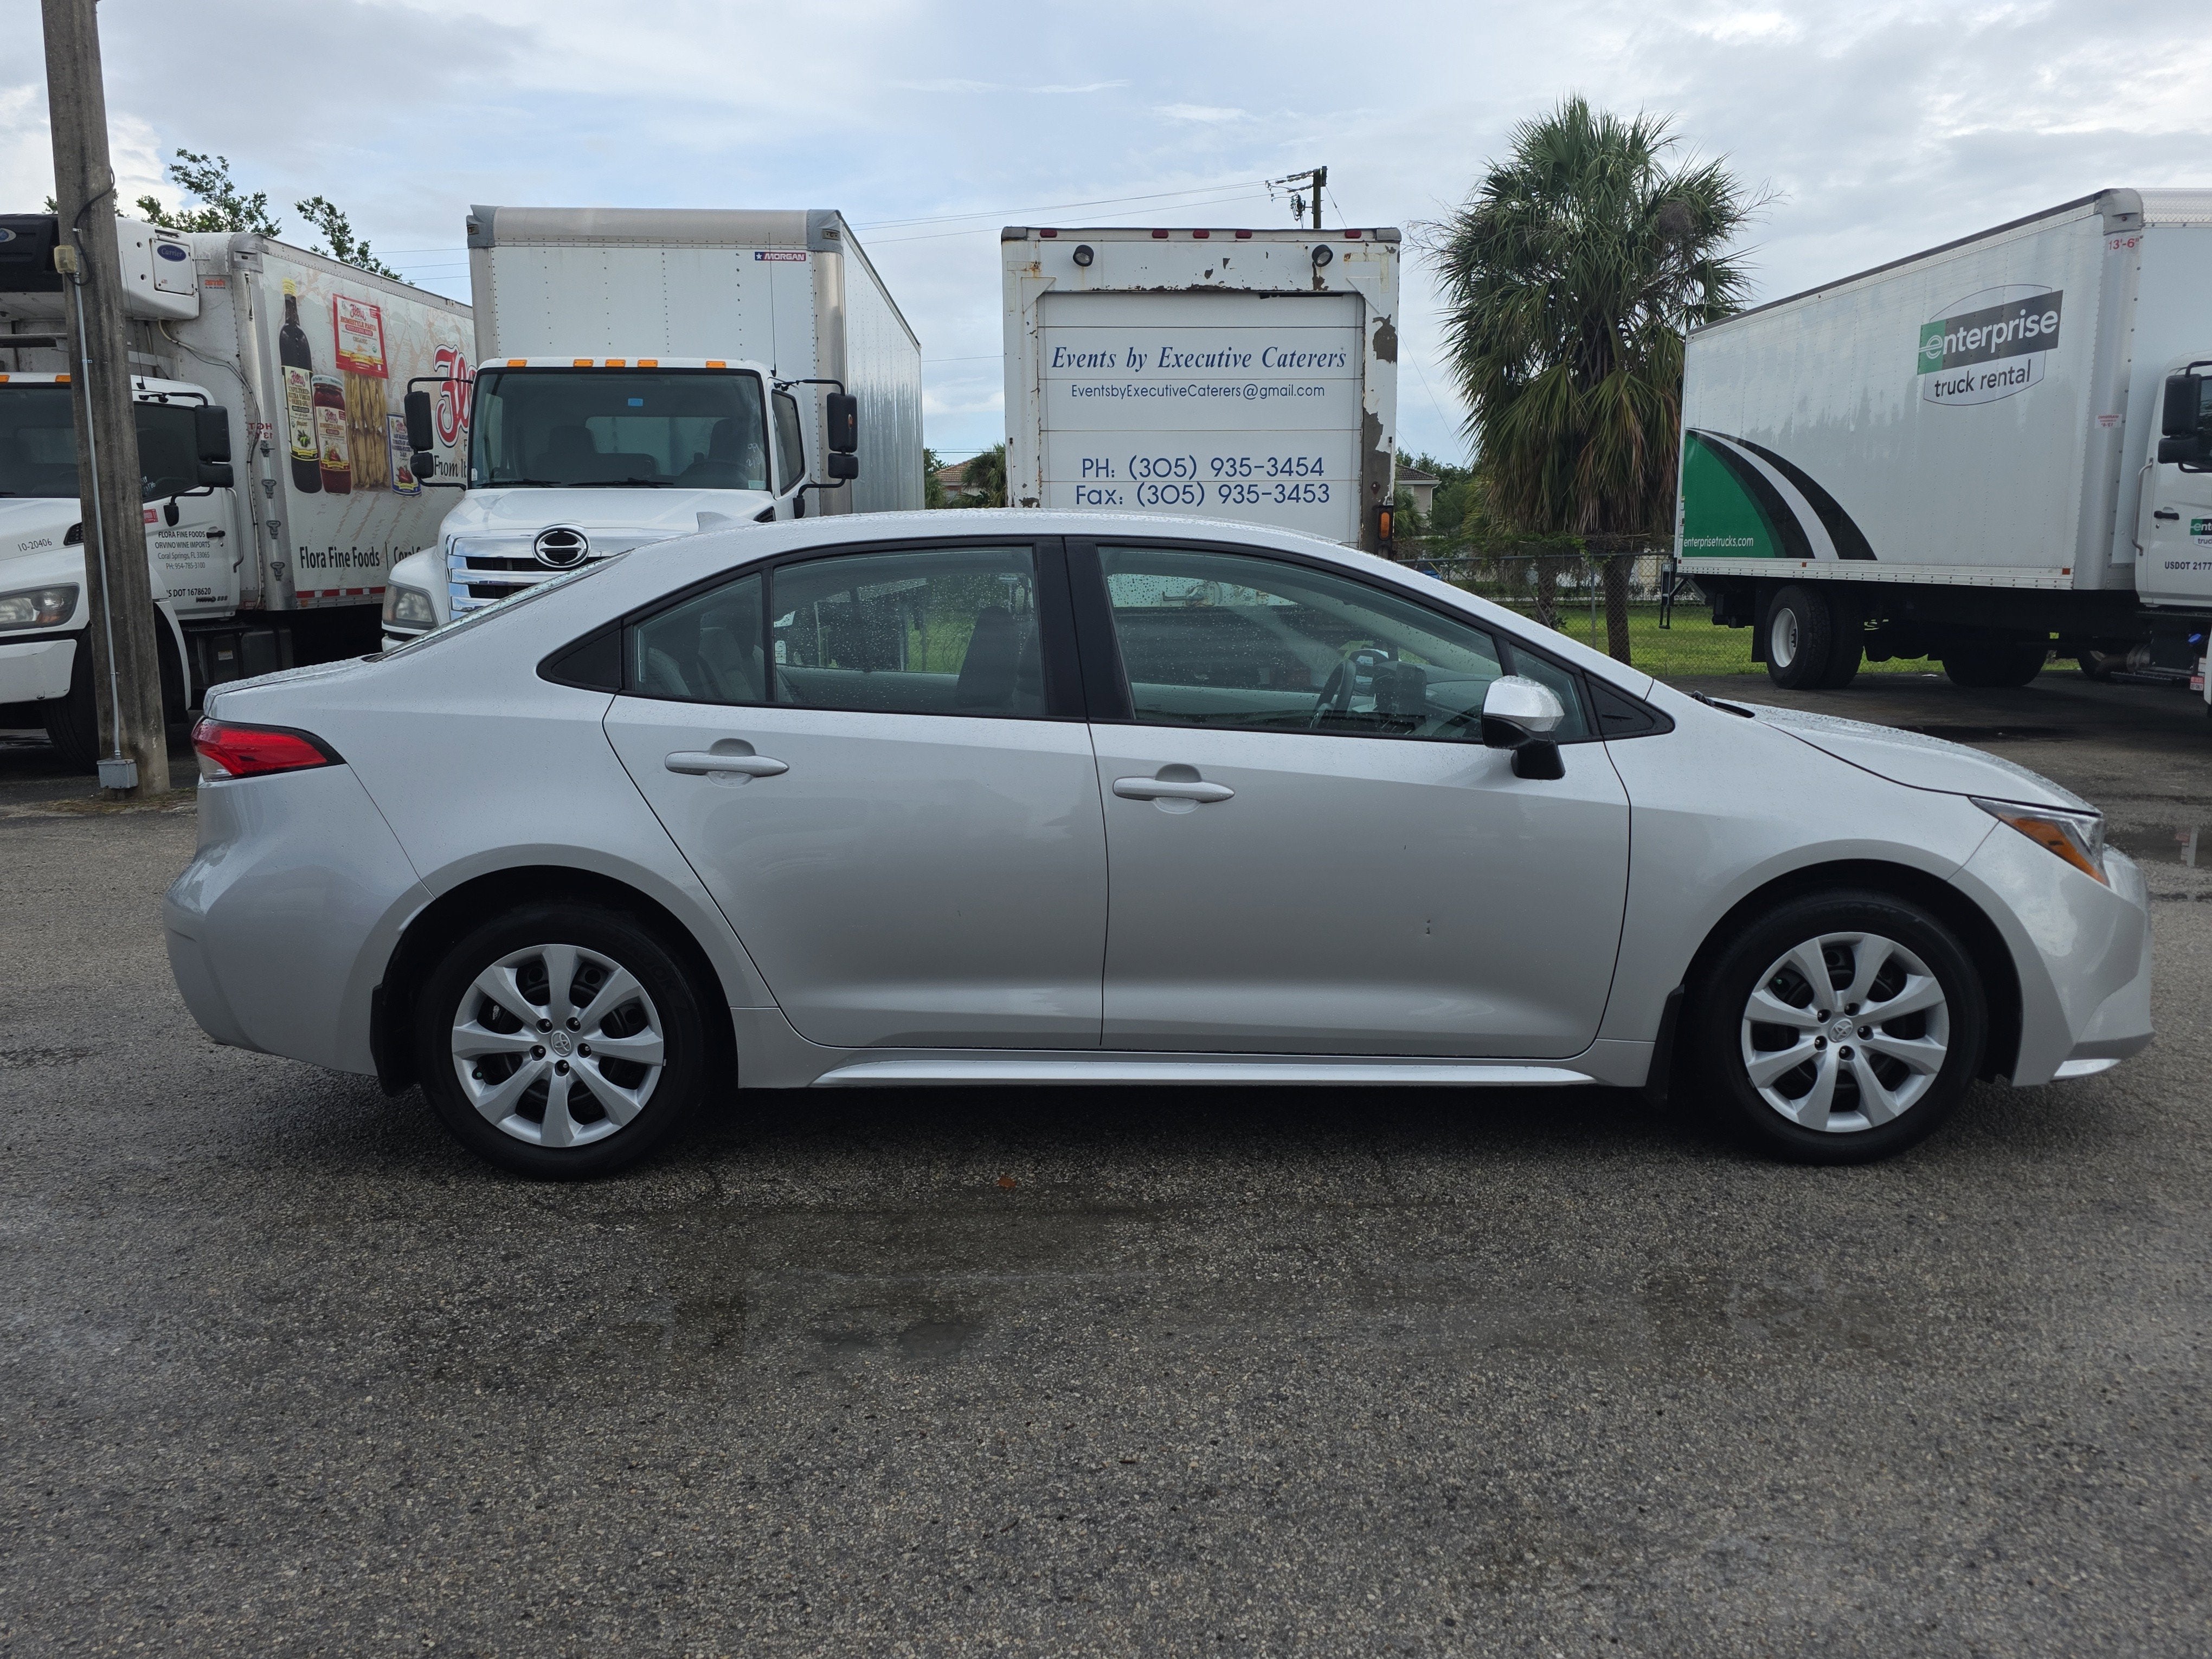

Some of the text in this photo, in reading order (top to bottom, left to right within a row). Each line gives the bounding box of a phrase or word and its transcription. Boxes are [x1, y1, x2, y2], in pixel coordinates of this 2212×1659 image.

[161, 248, 183, 258] Carrier
[2108, 238, 2140, 250] 13'-6"
[1918, 309, 2059, 359] enterprise
[1051, 346, 1347, 372] Events by Executive Caterers
[1934, 358, 2031, 397] truck rental
[434, 344, 477, 448] Fl
[1071, 383, 1325, 400] EventsbyExecutiveCaterers@gmail.com
[434, 455, 458, 478] From
[1082, 454, 1324, 480] PH: (305) 935-3454
[1076, 481, 1330, 507] Fax: (305) 935-3453
[17, 538, 53, 552] 10-20406
[1683, 535, 1754, 550] enterprisetrucks.com
[299, 546, 326, 569] Flora
[328, 546, 351, 568] Fine
[352, 546, 380, 568] Foods
[2165, 561, 2191, 570] USDOT
[173, 589, 186, 597] DOT
[187, 588, 211, 596] 1678620
